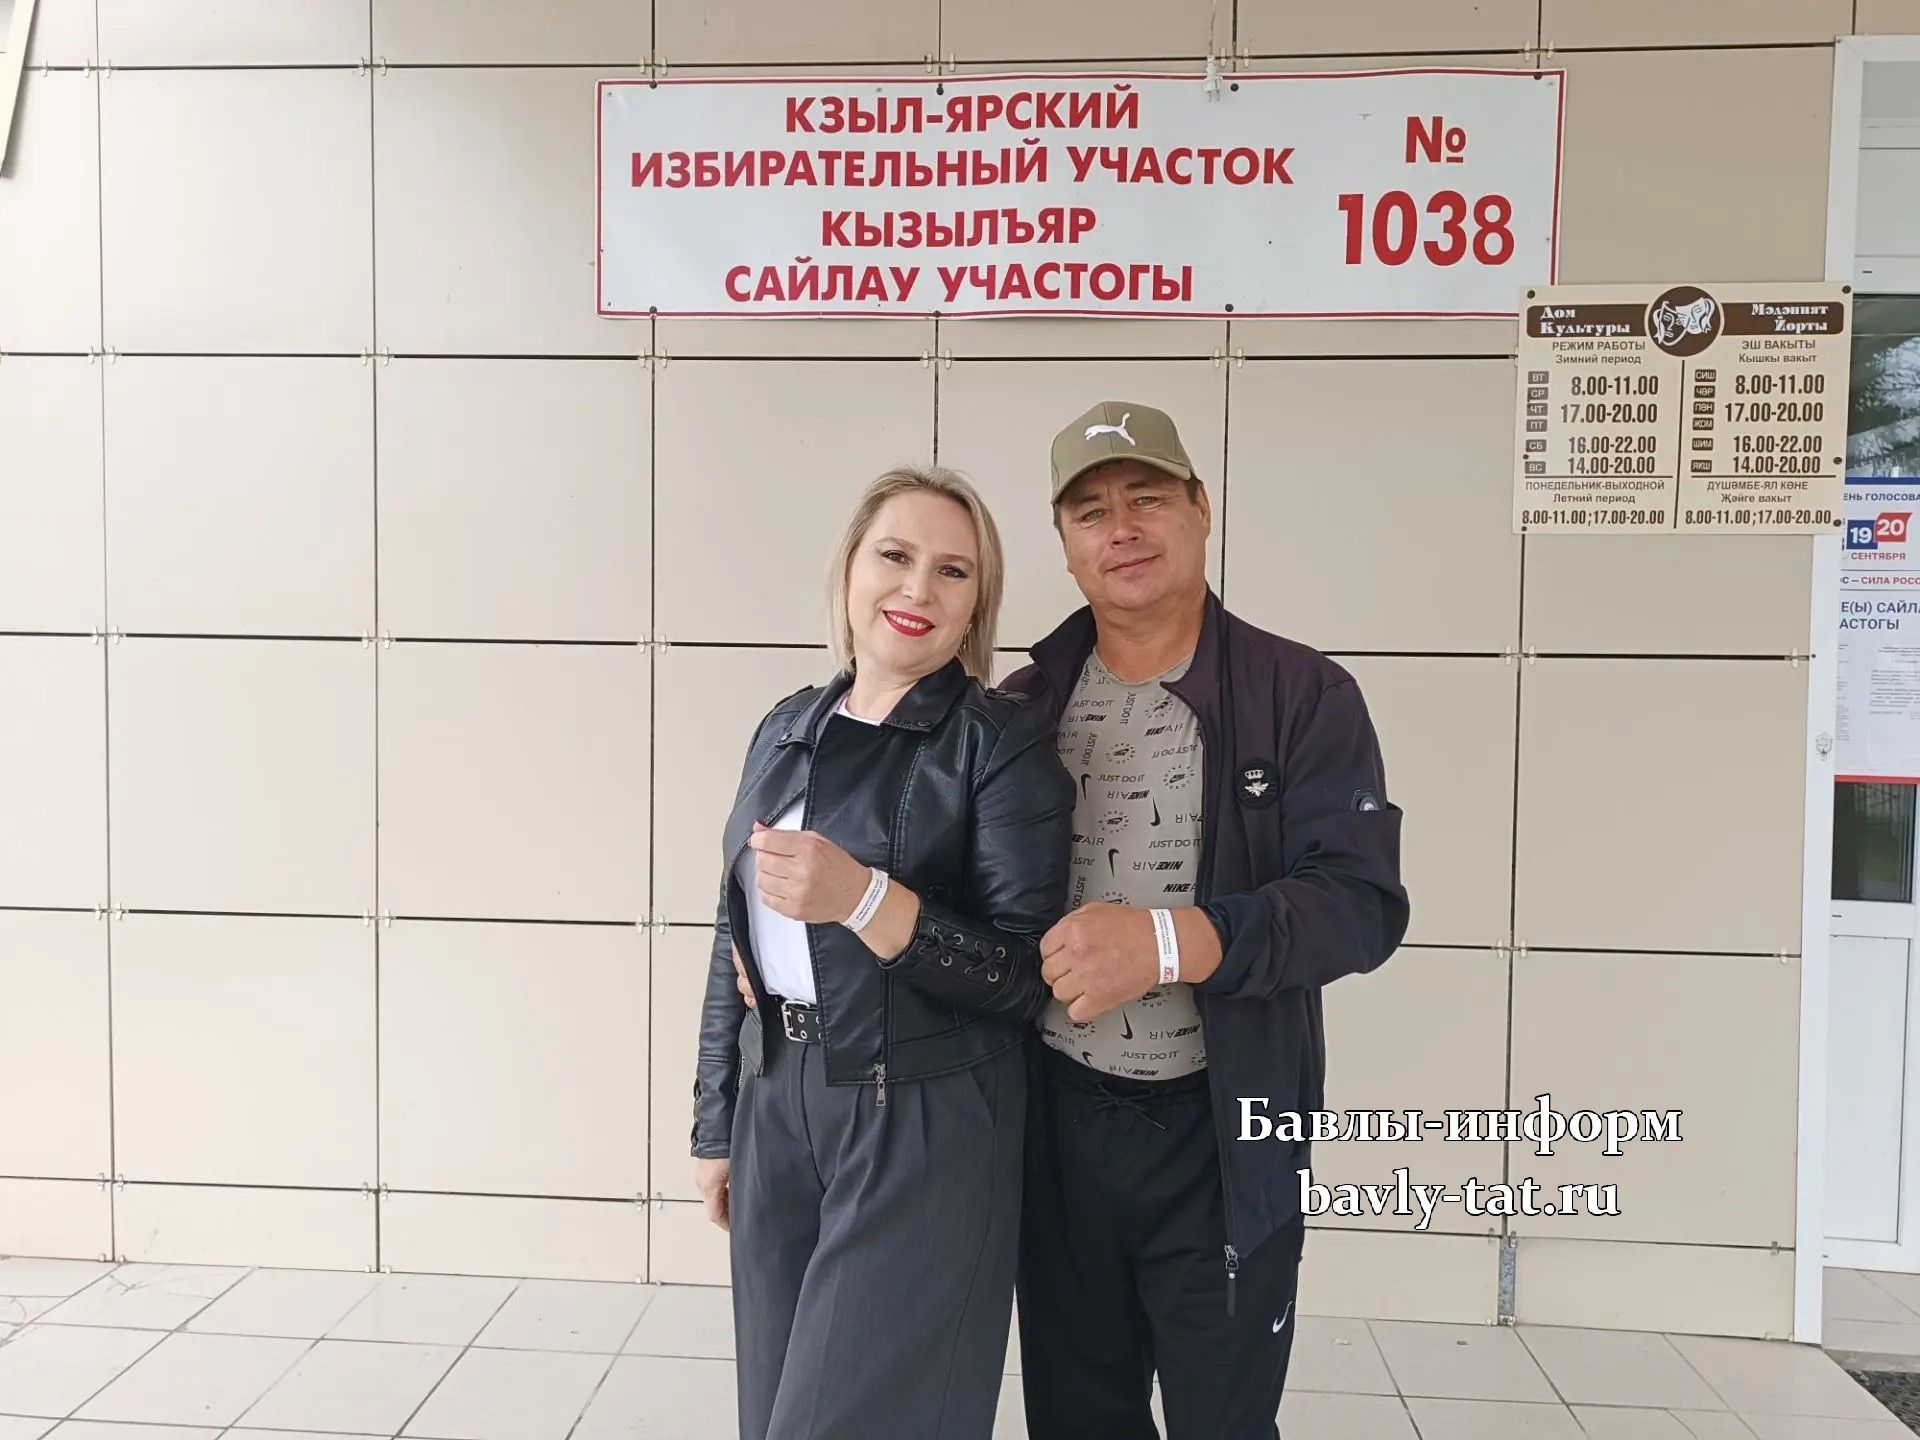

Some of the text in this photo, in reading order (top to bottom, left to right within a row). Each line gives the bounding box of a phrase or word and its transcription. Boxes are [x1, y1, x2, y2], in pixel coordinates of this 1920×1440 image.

[786, 83, 1139, 133] КЗЫЛ-ЯРСКИЙ
[1405, 116, 1467, 163] №
[631, 137, 1295, 188] ИЗБИРАТЕЛЬНЫЙ УЧАСТОК
[822, 208, 1097, 248] КЫЗЫЛЪЯР
[1338, 190, 1515, 266] 1038
[725, 256, 1192, 302] САЙЛАУ УЧАСТОГЫ
[1540, 306, 1576, 320] Дом
[1540, 321, 1631, 337] Культуры
[1774, 316, 1828, 334] Йорты
[1552, 341, 1646, 351] РЕЖИМ РАБОТЫ
[1742, 340, 1816, 350] ЭШ ВАКЫТЫ
[1556, 354, 1642, 365] Зимний период
[1739, 353, 1817, 363] Кышкы вакыт
[1531, 374, 1546, 383] ВТ
[1695, 371, 1715, 379] СИШ
[1571, 376, 1659, 395] 8.00-11.00
[1735, 374, 1825, 394] 8.00-11.00
[1530, 390, 1546, 399] СР
[1529, 406, 1545, 414] ЧТ
[1560, 403, 1658, 423] 17.00-20.00
[1725, 402, 1824, 422] 17.00-20.00
[1529, 421, 1545, 430] ПТ
[1528, 442, 1544, 451] СБ
[1568, 436, 1657, 454] 16.00-22.00
[1733, 435, 1822, 453] 16.00-22.00
[1528, 463, 1544, 472] ВС
[1568, 456, 1655, 474] 14.00-20.00
[1733, 456, 1821, 473] 14.00-20.00
[1525, 480, 1665, 491] ПОНЕДЕЛЬНИК-ВЫХОДНОЙ
[1553, 493, 1636, 504] Летний период
[1758, 495, 1792, 503] вакыт
[1850, 527, 1873, 544] 19
[1877, 519, 1905, 536] 20
[1851, 552, 1906, 560] СЕНТЯБРЯ
[1840, 576, 1849, 584] С
[1861, 576, 1890, 584] СИЛА
[1841, 600, 1920, 615] Е(Ы) САЙЛ
[1839, 618, 1900, 630] АСТОГЫ
[1097, 774, 1120, 782] JUST
[1122, 775, 1136, 783] DO
[1149, 840, 1174, 849] JUST
[1174, 839, 1191, 847] DO
[1121, 1050, 1147, 1060] JUST
[1168, 1050, 1180, 1058] IT
